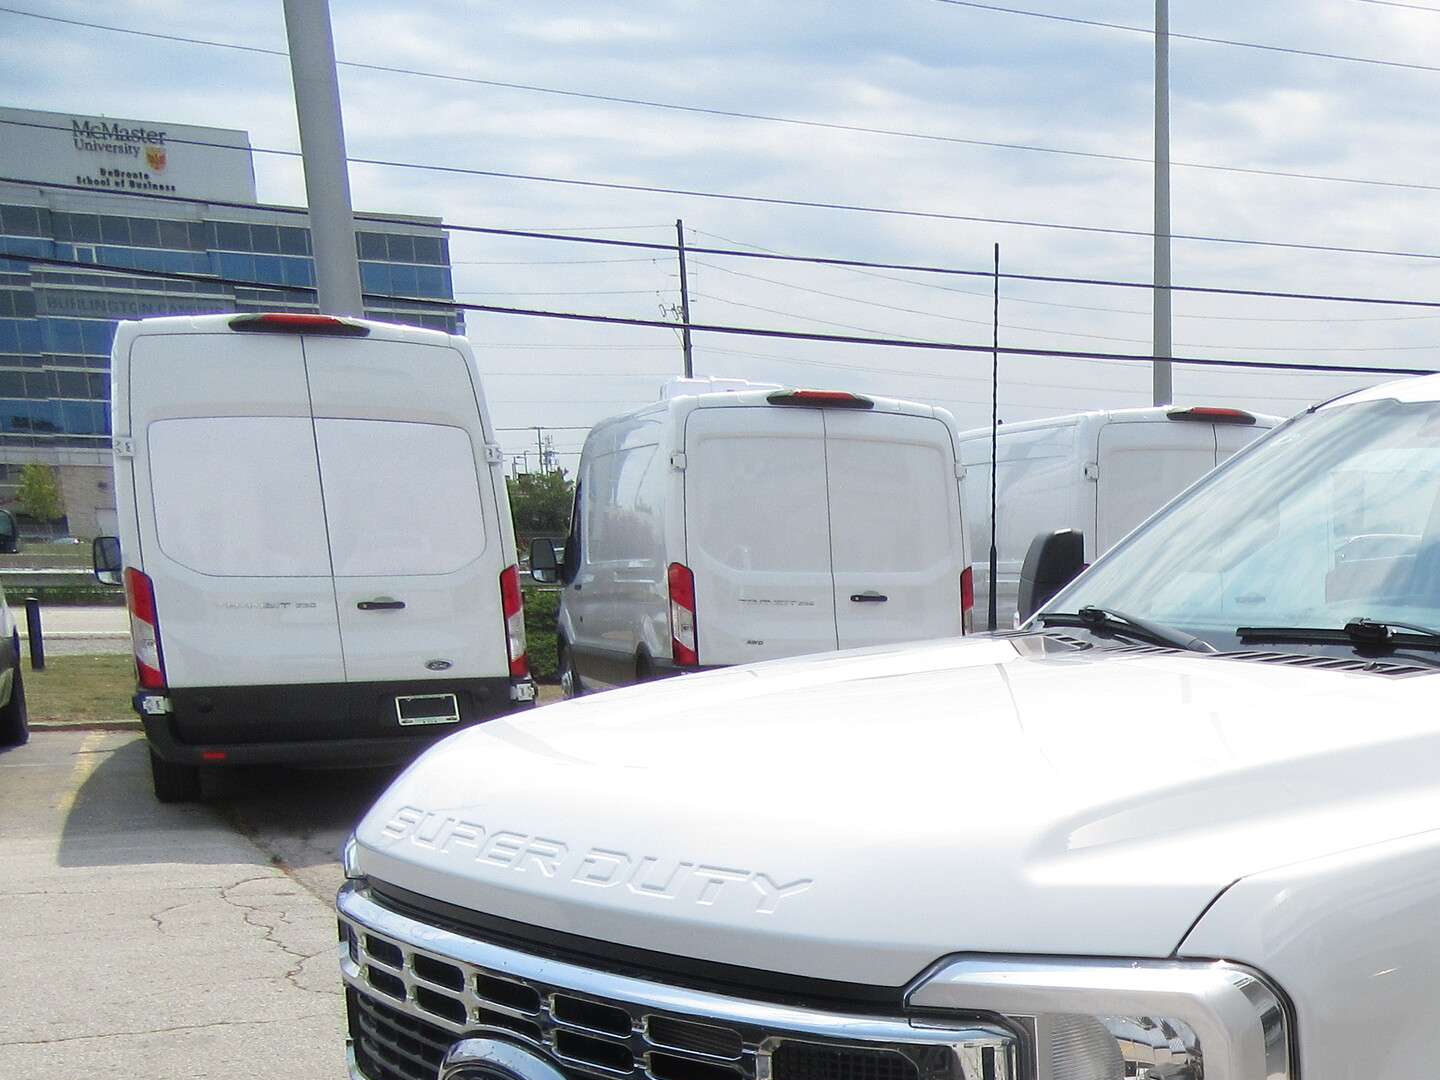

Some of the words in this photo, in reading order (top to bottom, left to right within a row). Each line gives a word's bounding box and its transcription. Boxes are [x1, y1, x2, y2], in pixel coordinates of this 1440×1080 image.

[72, 119, 167, 145] McMaster
[74, 138, 140, 158] University
[77, 175, 111, 187] School
[114, 179, 125, 188] of
[129, 180, 177, 192] Business
[381, 805, 570, 879] SUPER
[571, 846, 816, 916] DUTY
